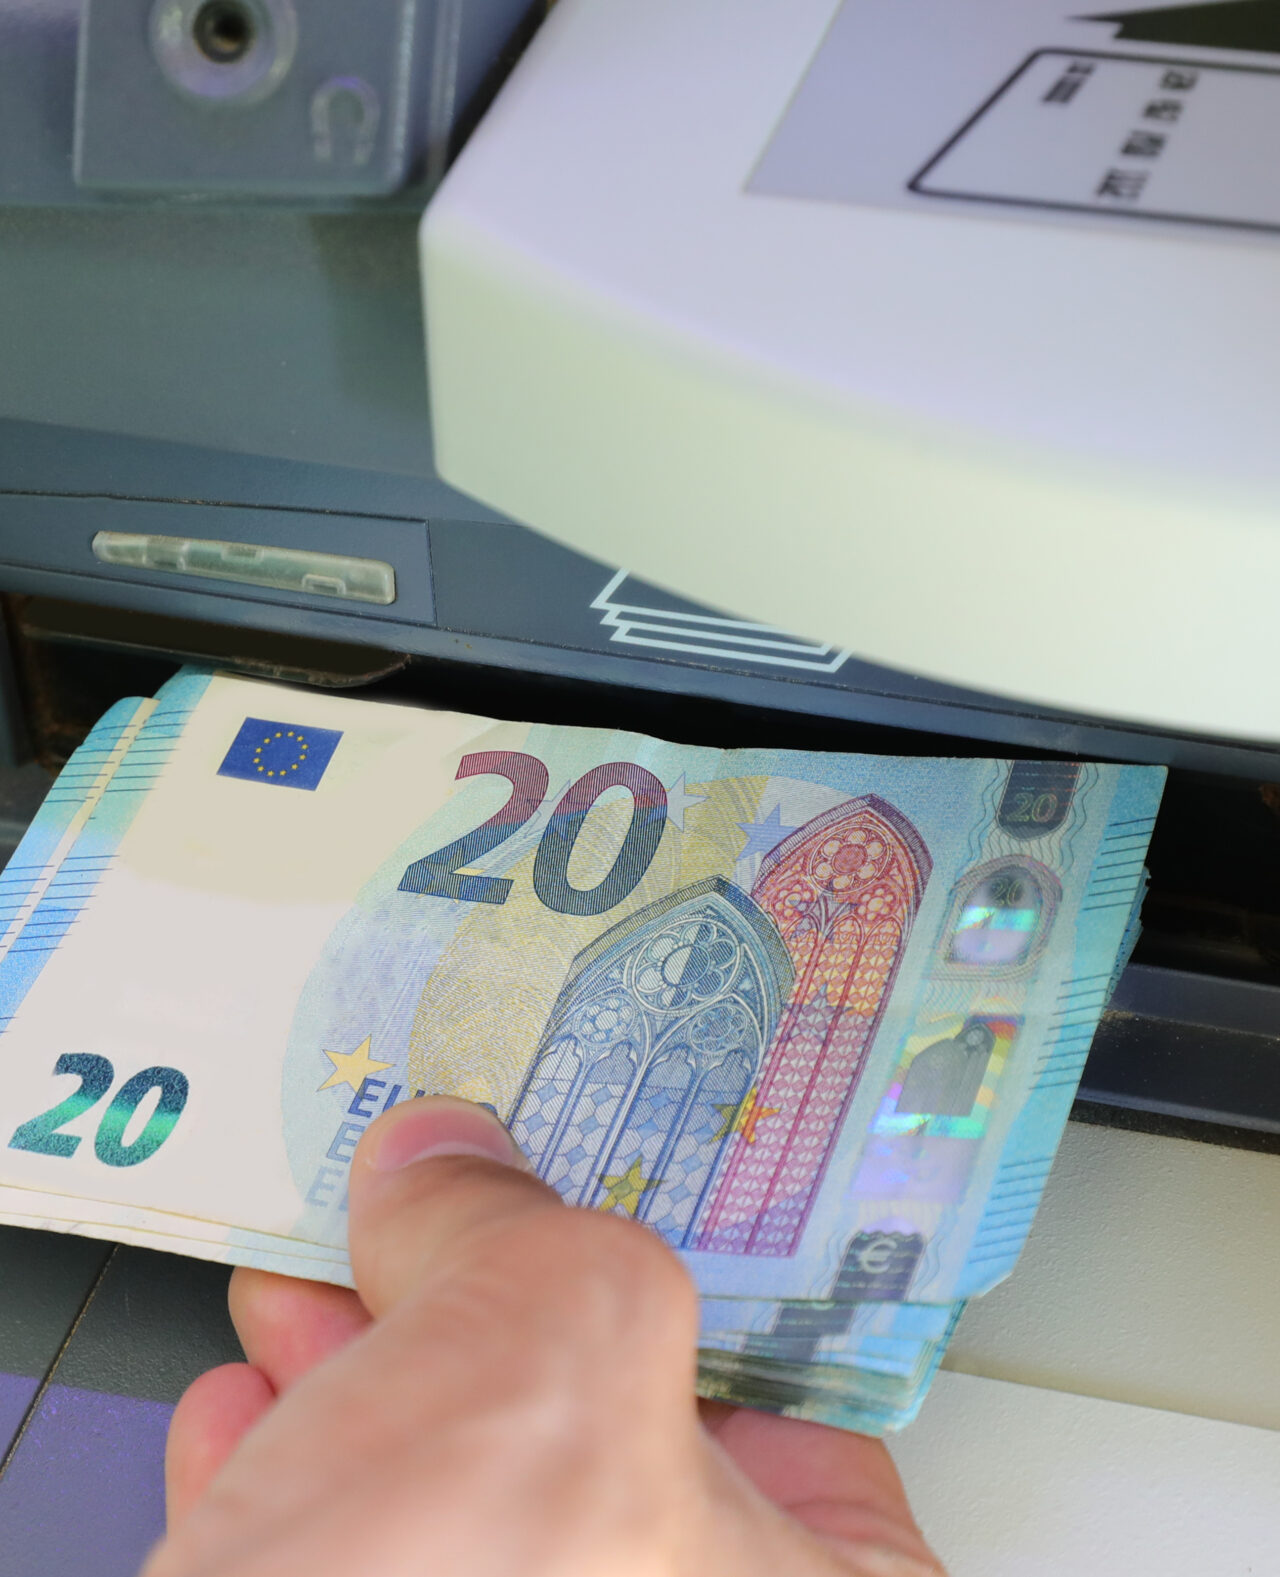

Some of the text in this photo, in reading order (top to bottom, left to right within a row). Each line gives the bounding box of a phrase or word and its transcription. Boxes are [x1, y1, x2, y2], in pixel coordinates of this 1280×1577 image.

[397, 751, 668, 916] 20
[1007, 792, 1058, 823] 20
[7, 1052, 189, 1168] 20
